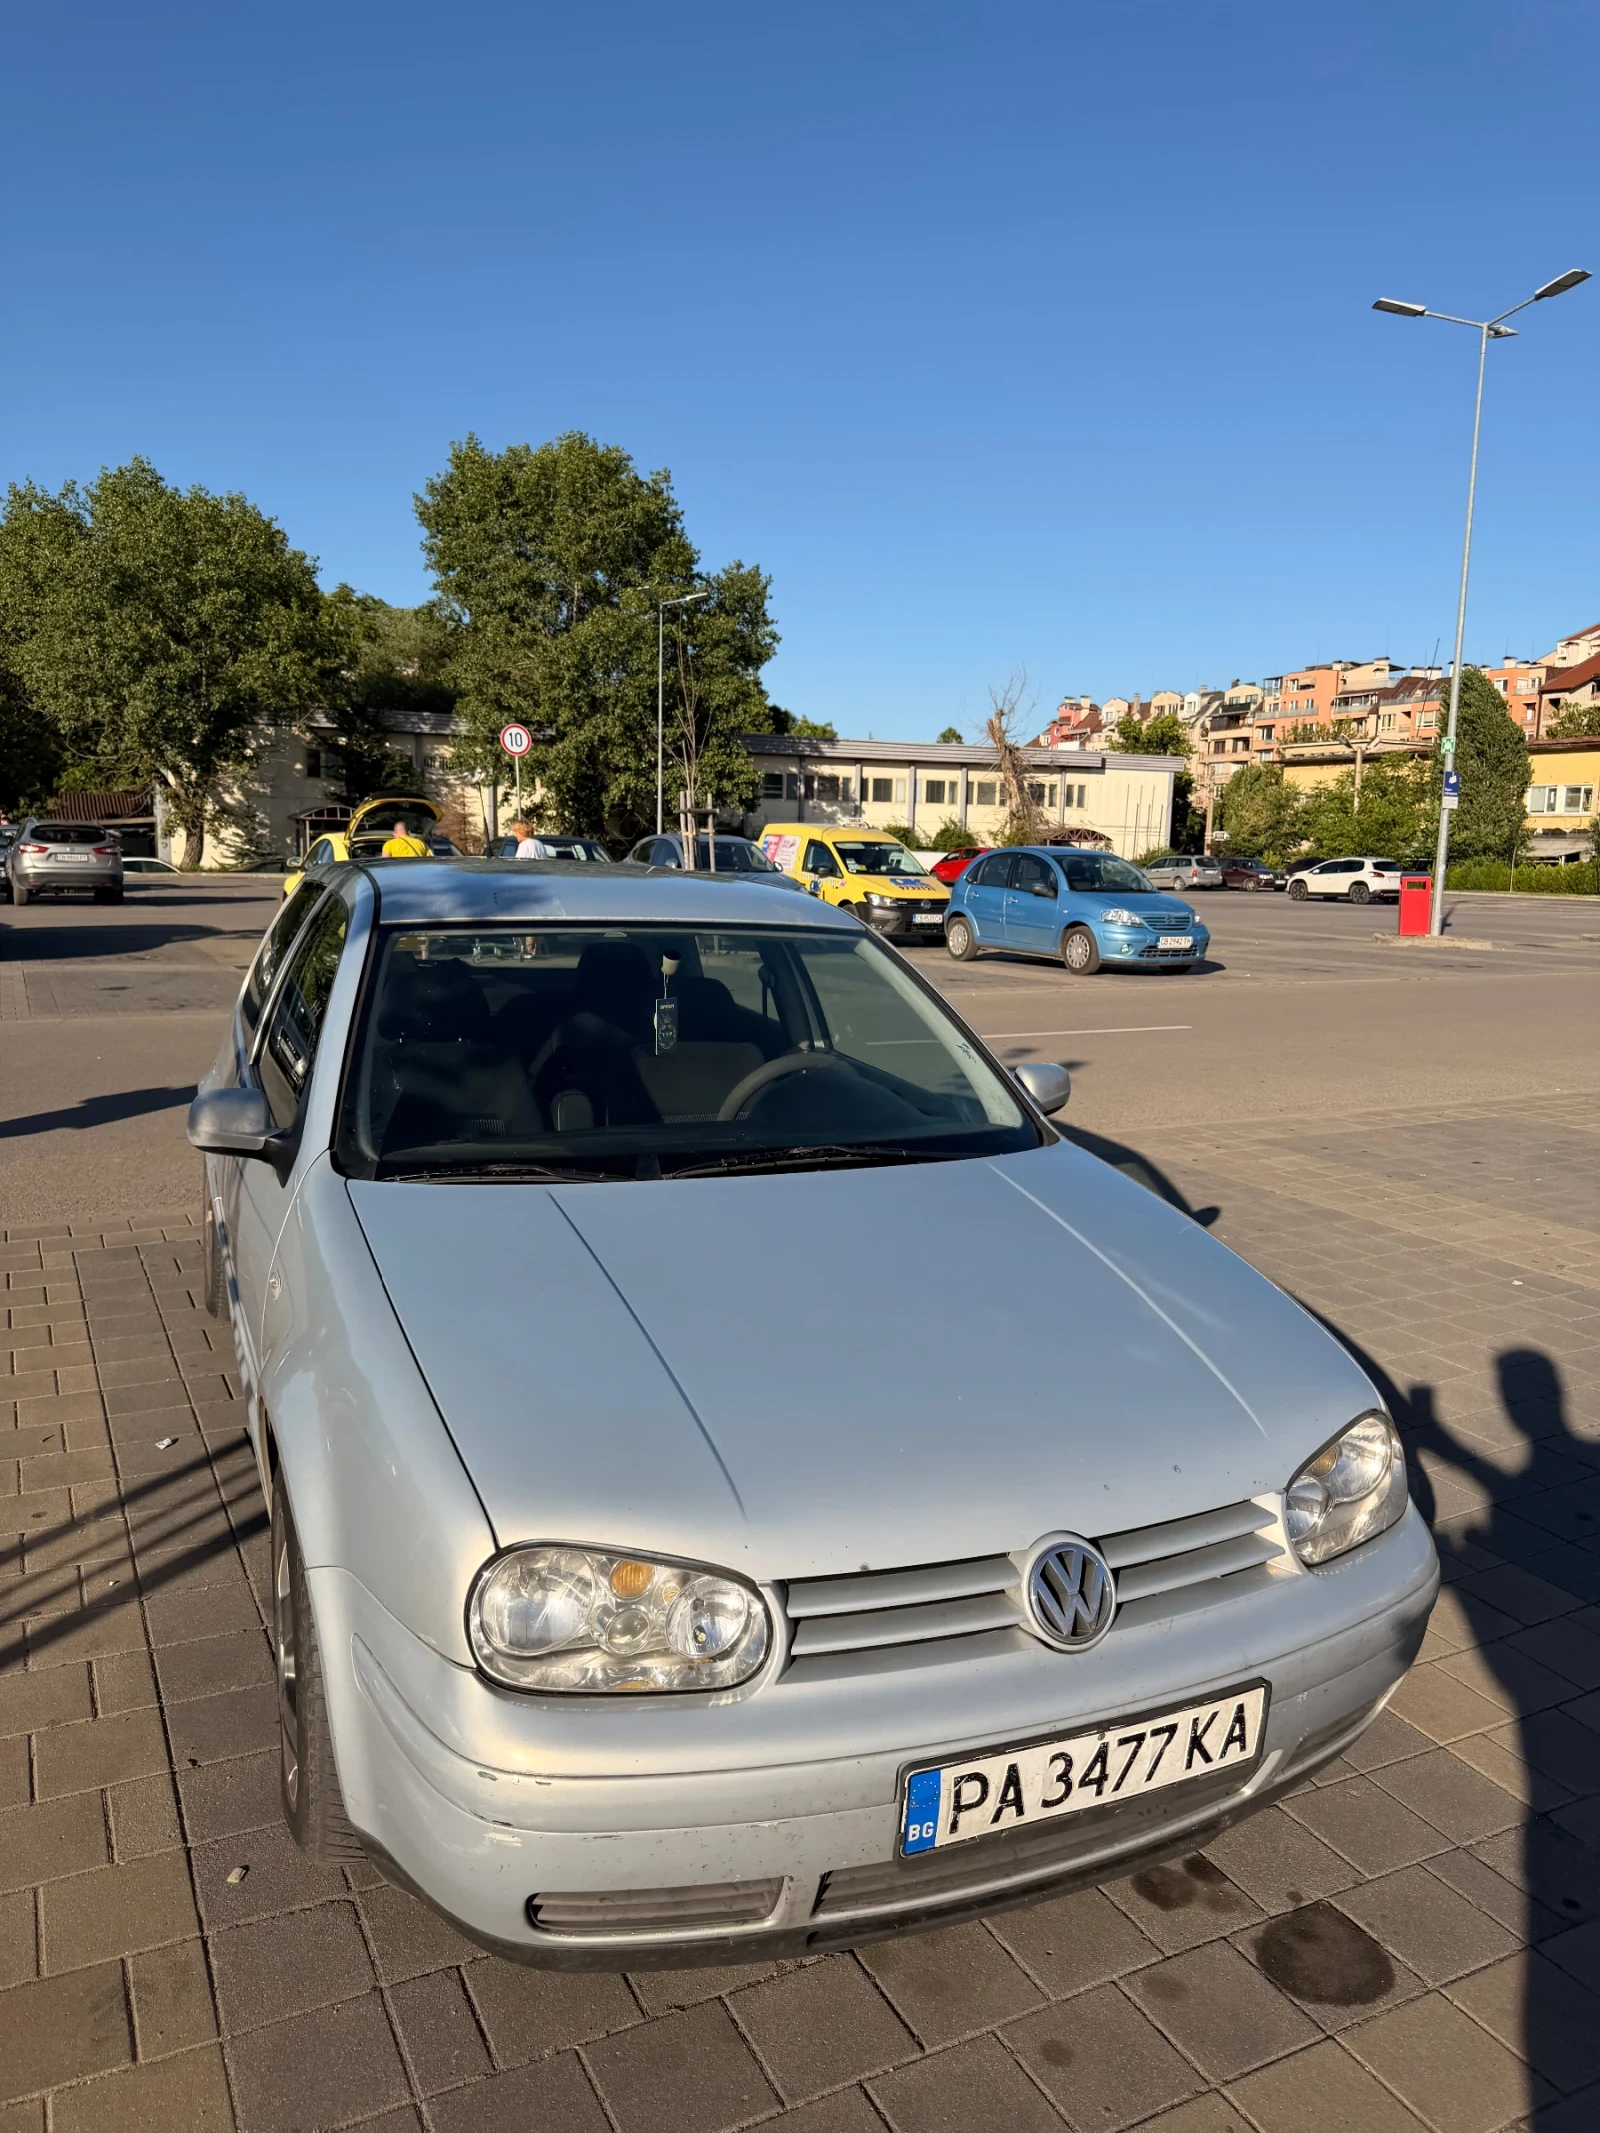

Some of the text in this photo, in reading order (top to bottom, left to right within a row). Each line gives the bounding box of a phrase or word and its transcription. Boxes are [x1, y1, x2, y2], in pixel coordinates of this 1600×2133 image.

[509, 732, 523, 747] 10
[949, 1702, 1247, 1835] PA 3477 KA
[908, 1821, 934, 1842] BG
